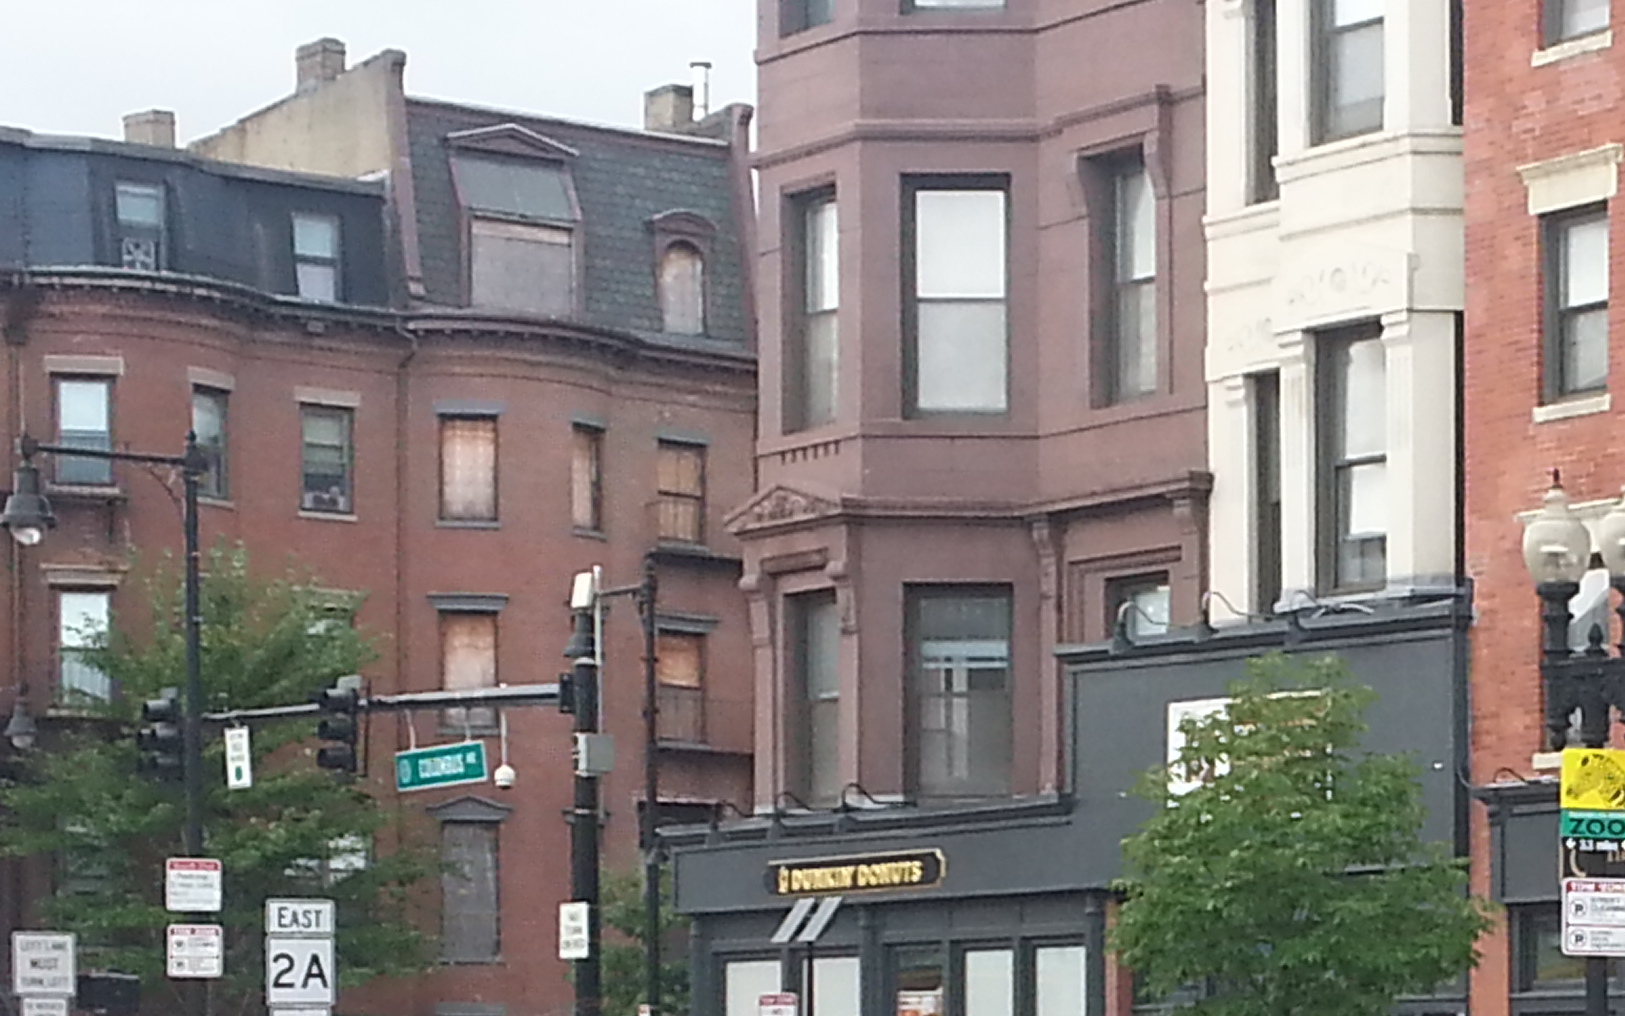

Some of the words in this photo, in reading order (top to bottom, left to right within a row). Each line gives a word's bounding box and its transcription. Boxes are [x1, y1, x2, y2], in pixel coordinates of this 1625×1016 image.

[857, 860, 924, 887] DONUTS
[277, 907, 323, 928] EAST
[272, 952, 329, 988] 2A
